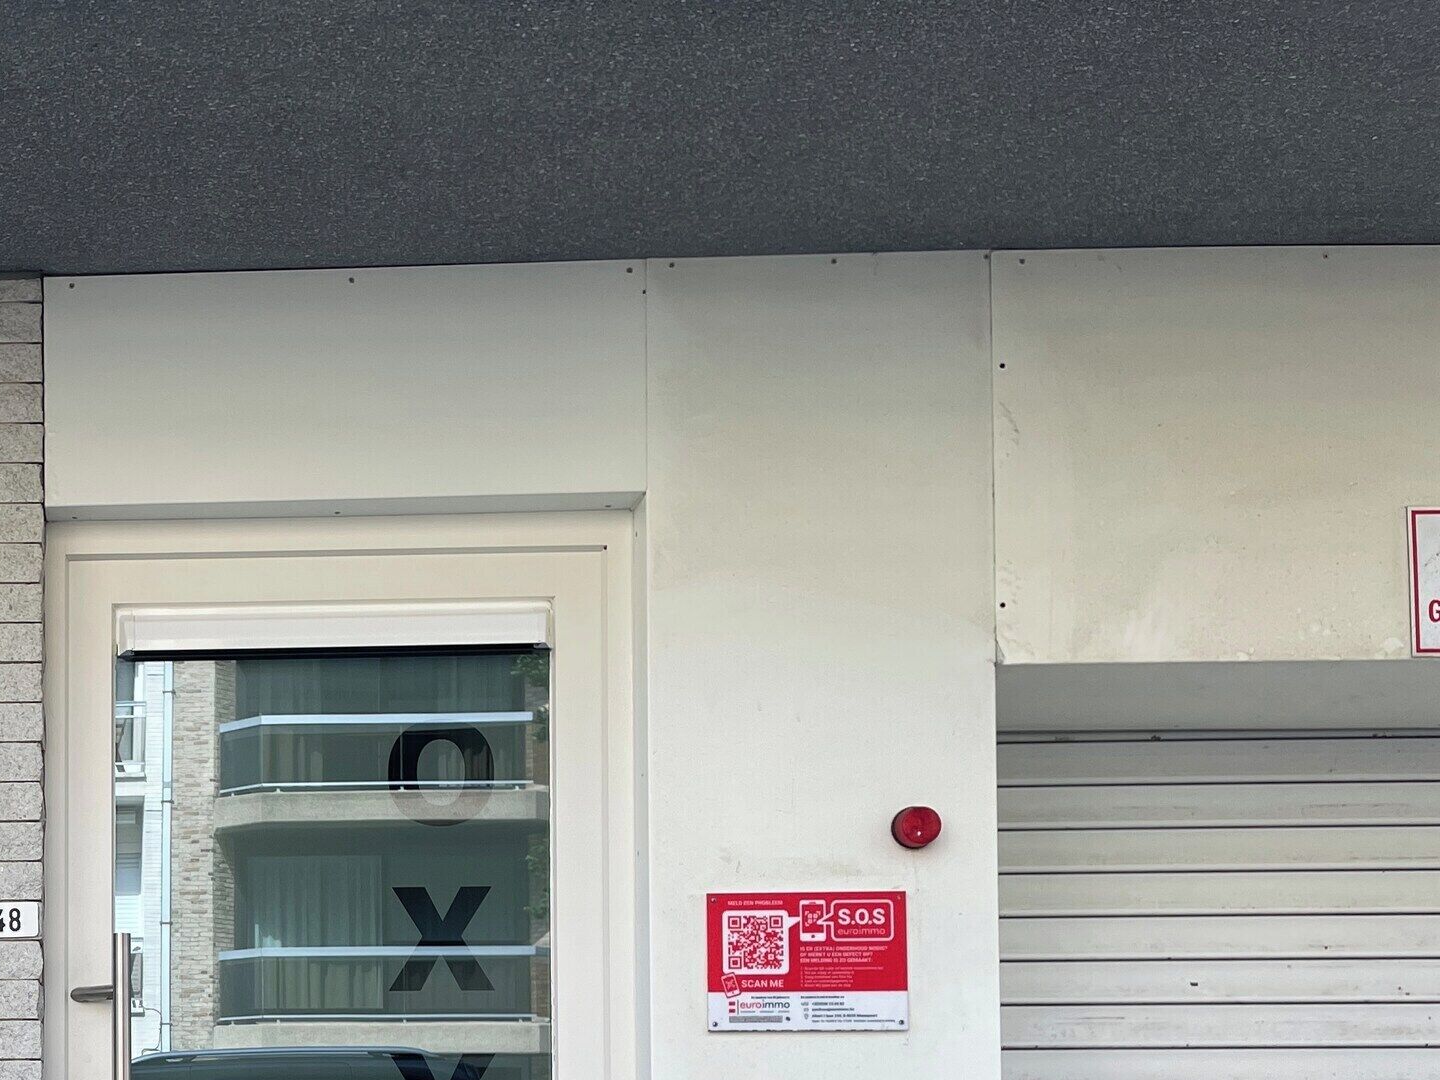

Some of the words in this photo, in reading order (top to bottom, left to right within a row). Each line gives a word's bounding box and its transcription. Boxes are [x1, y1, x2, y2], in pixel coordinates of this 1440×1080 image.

[837, 908, 886, 925] S.O.S
[837, 927, 886, 935] euroimmo
[741, 979, 767, 988] SCAN
[769, 979, 784, 988] ME
[740, 1000, 791, 1009] euroimmo
